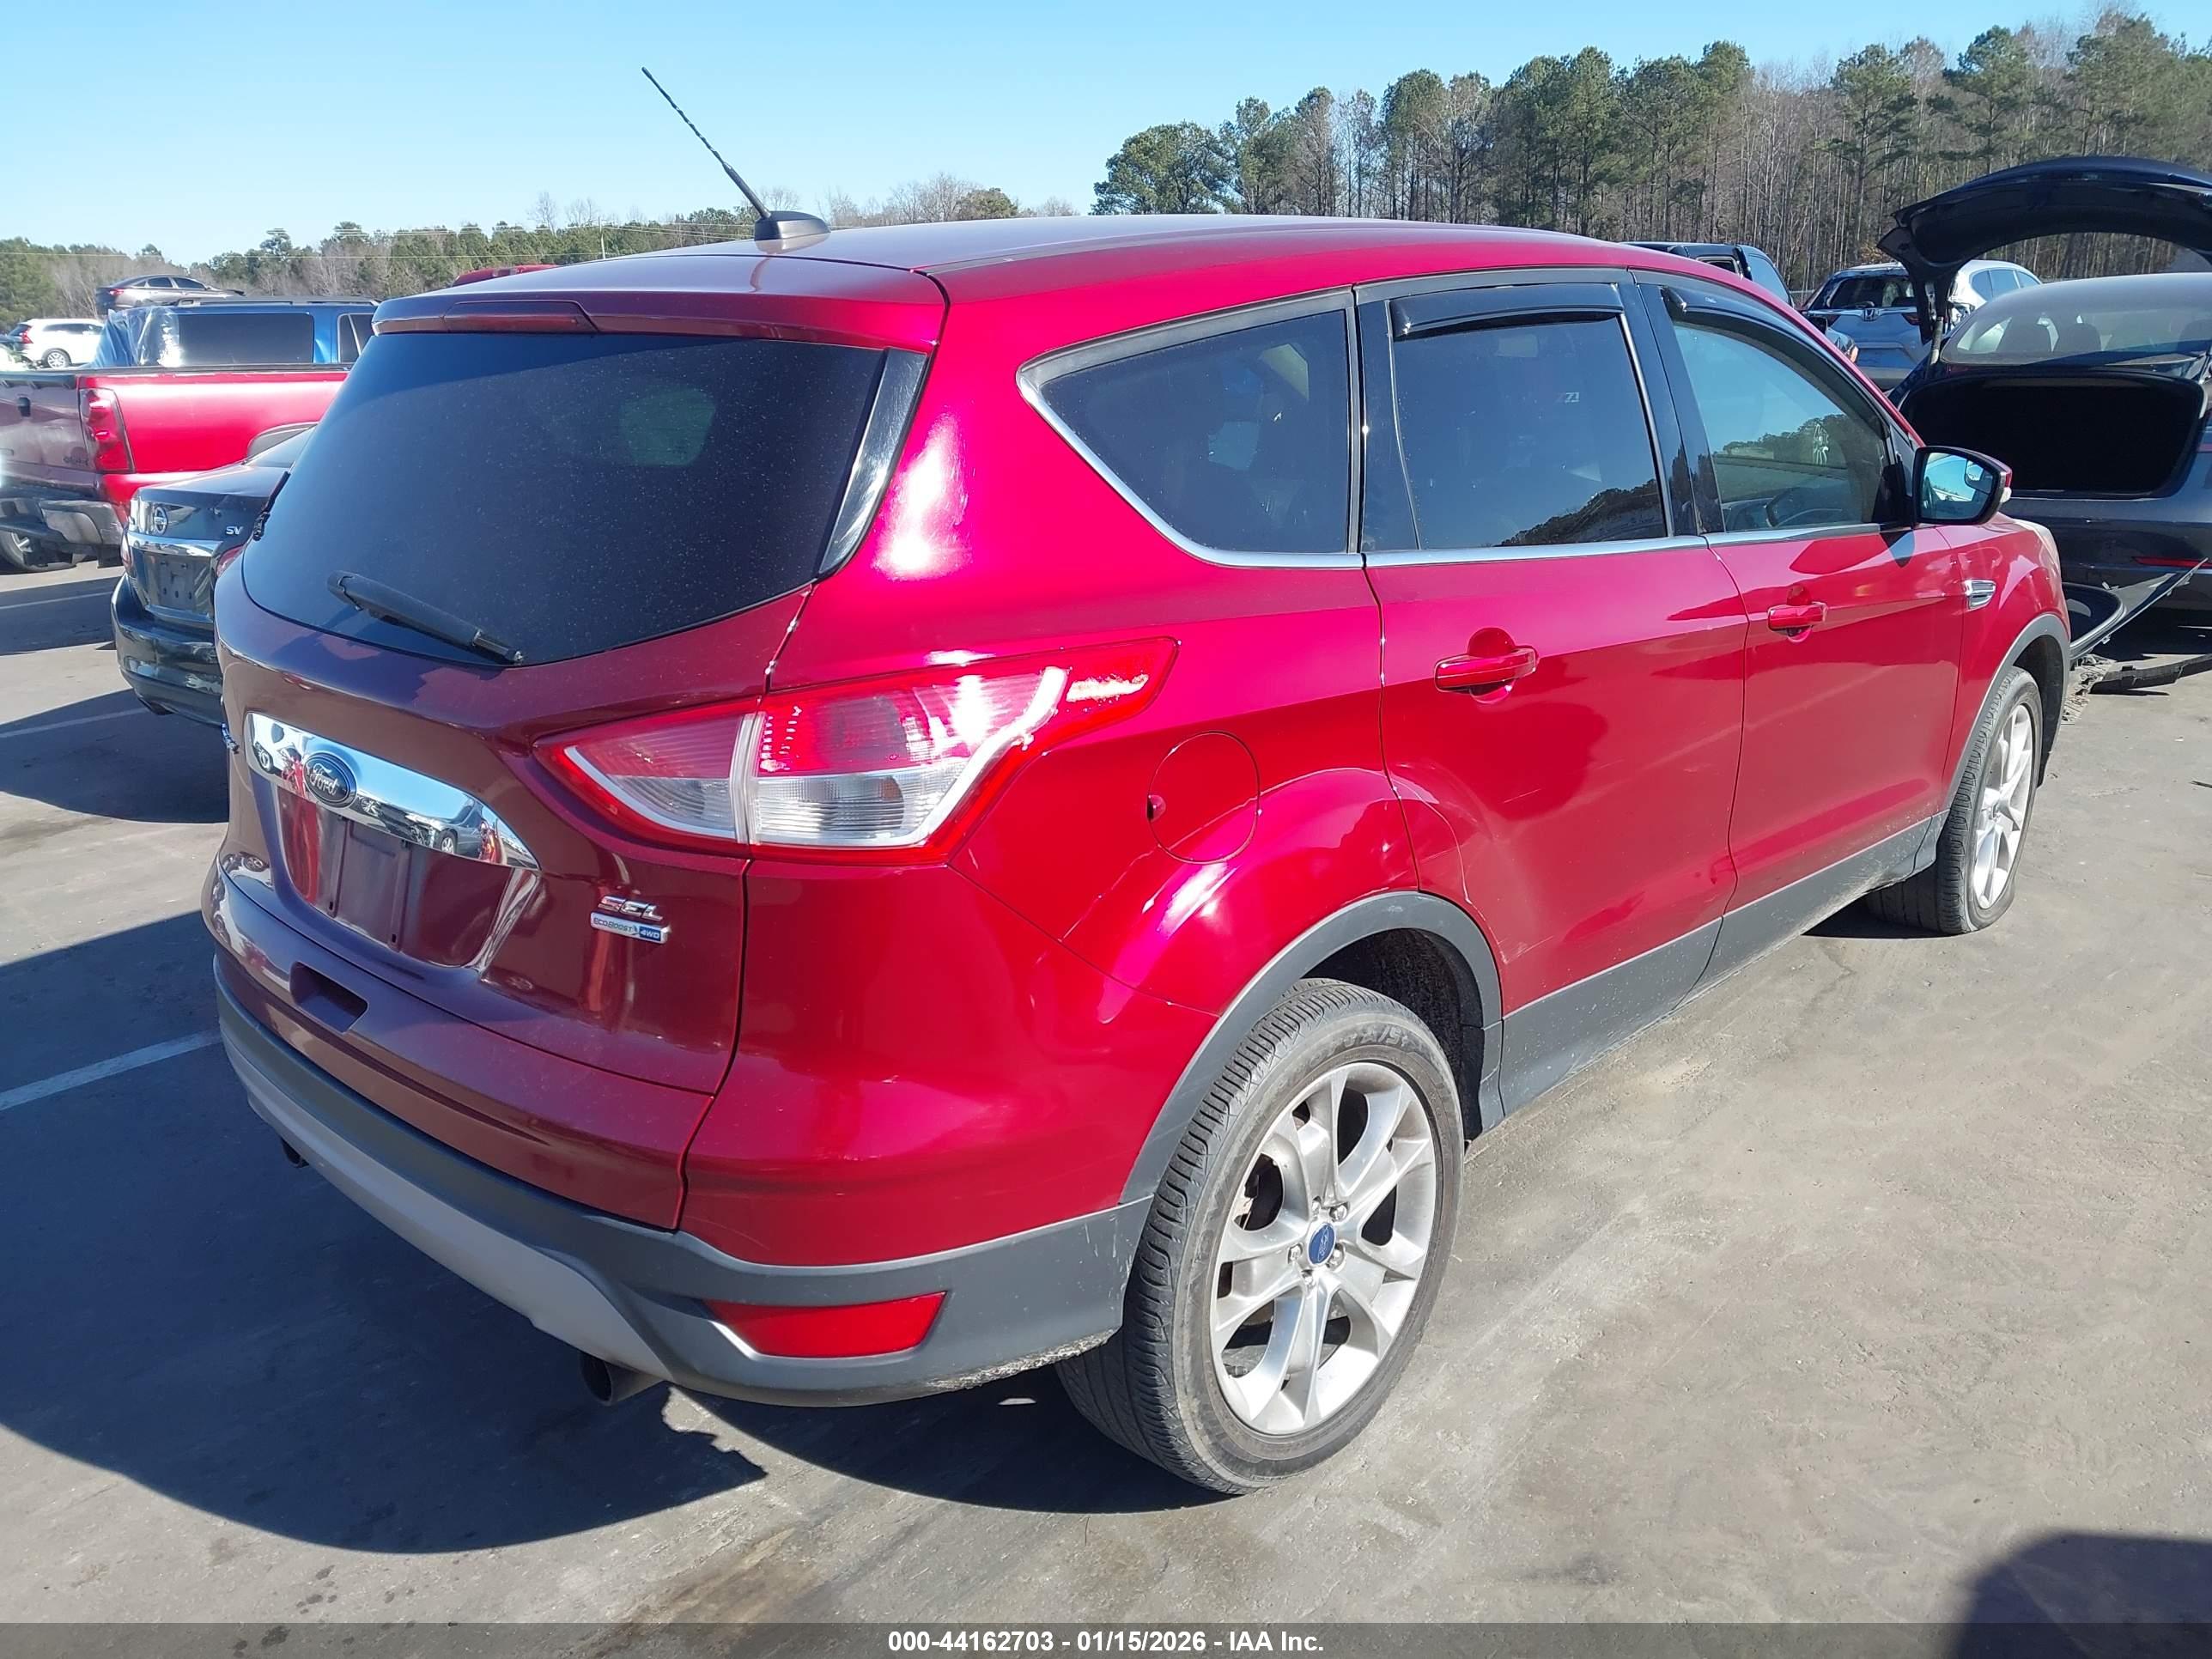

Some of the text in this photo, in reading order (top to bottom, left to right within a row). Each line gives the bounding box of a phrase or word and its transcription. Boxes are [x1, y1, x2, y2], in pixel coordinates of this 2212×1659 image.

[226, 526, 243, 535] SV
[309, 763, 340, 795] Ford
[640, 928, 660, 939] 4WD
